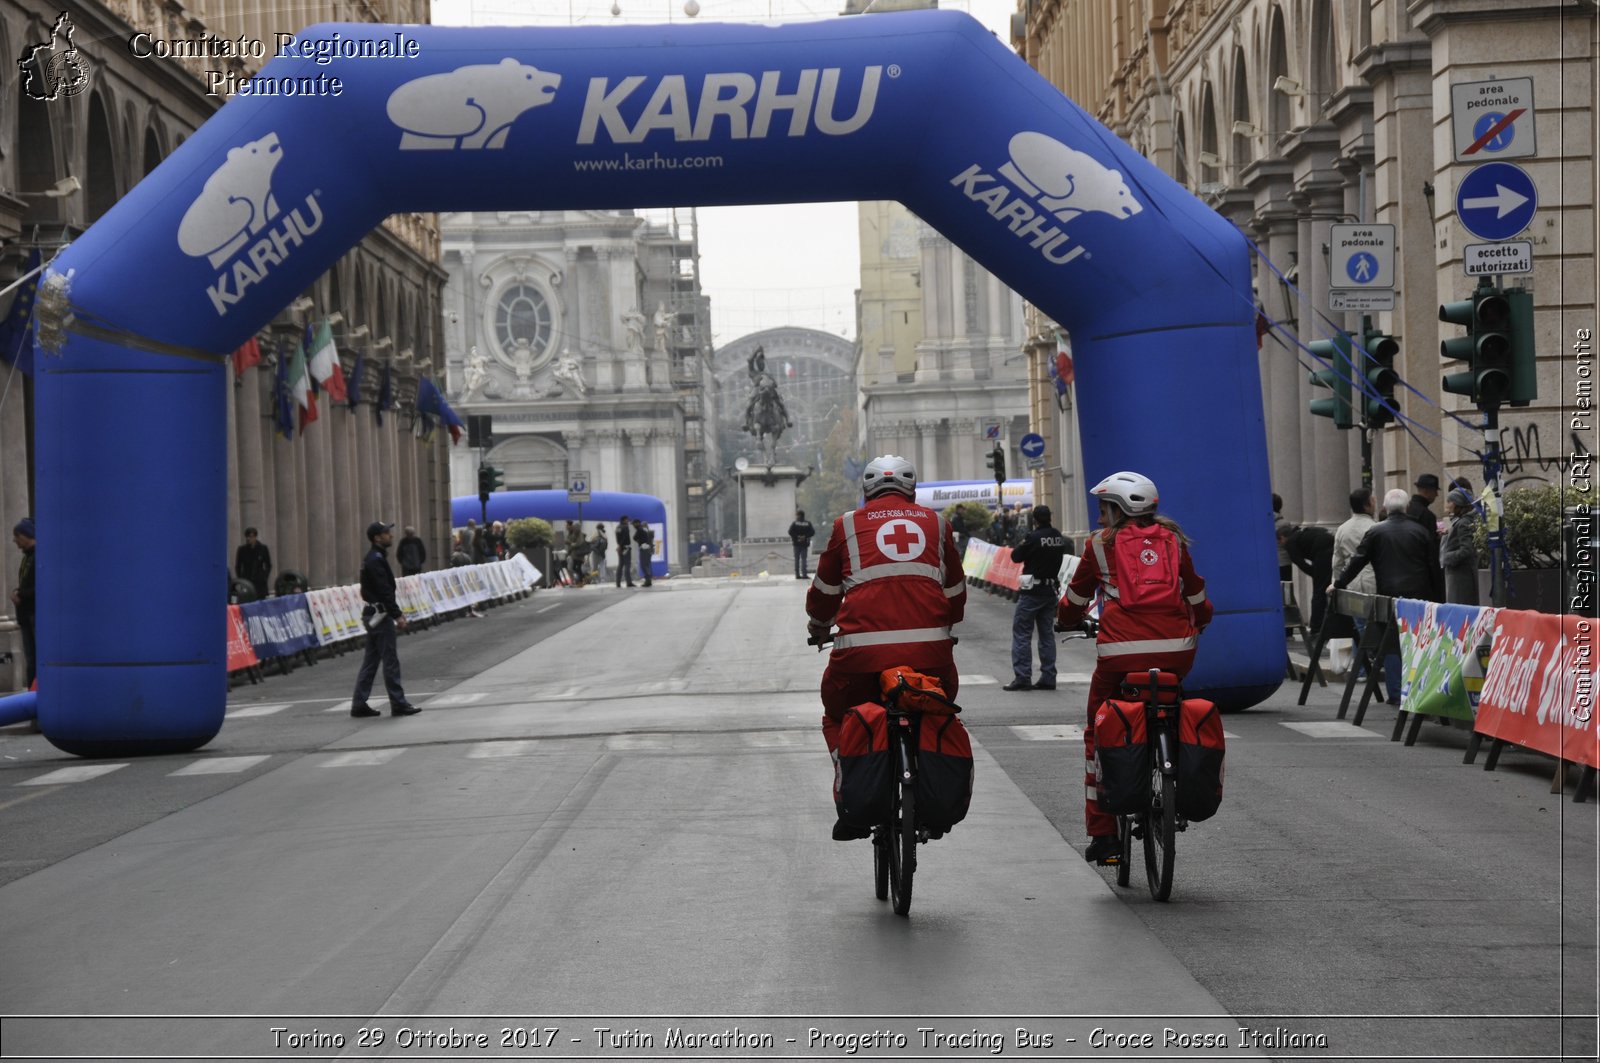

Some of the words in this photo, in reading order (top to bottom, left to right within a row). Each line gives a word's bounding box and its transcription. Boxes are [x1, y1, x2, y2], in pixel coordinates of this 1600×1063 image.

[1479, 85, 1504, 95] area
[1466, 95, 1520, 110] pedonale
[573, 152, 723, 171] www.karhu.com
[950, 163, 1086, 265] KARHU
[1341, 238, 1384, 247] pedonale
[206, 193, 323, 316] KARHU
[1478, 246, 1519, 258] eccetto
[1469, 259, 1528, 273] autorizzati
[933, 488, 979, 500] Maratona
[981, 488, 991, 497] di
[994, 485, 1025, 496] Trino
[867, 510, 886, 520] CROCE
[887, 509, 904, 517] ROSSA
[904, 509, 928, 519] ITALIANA
